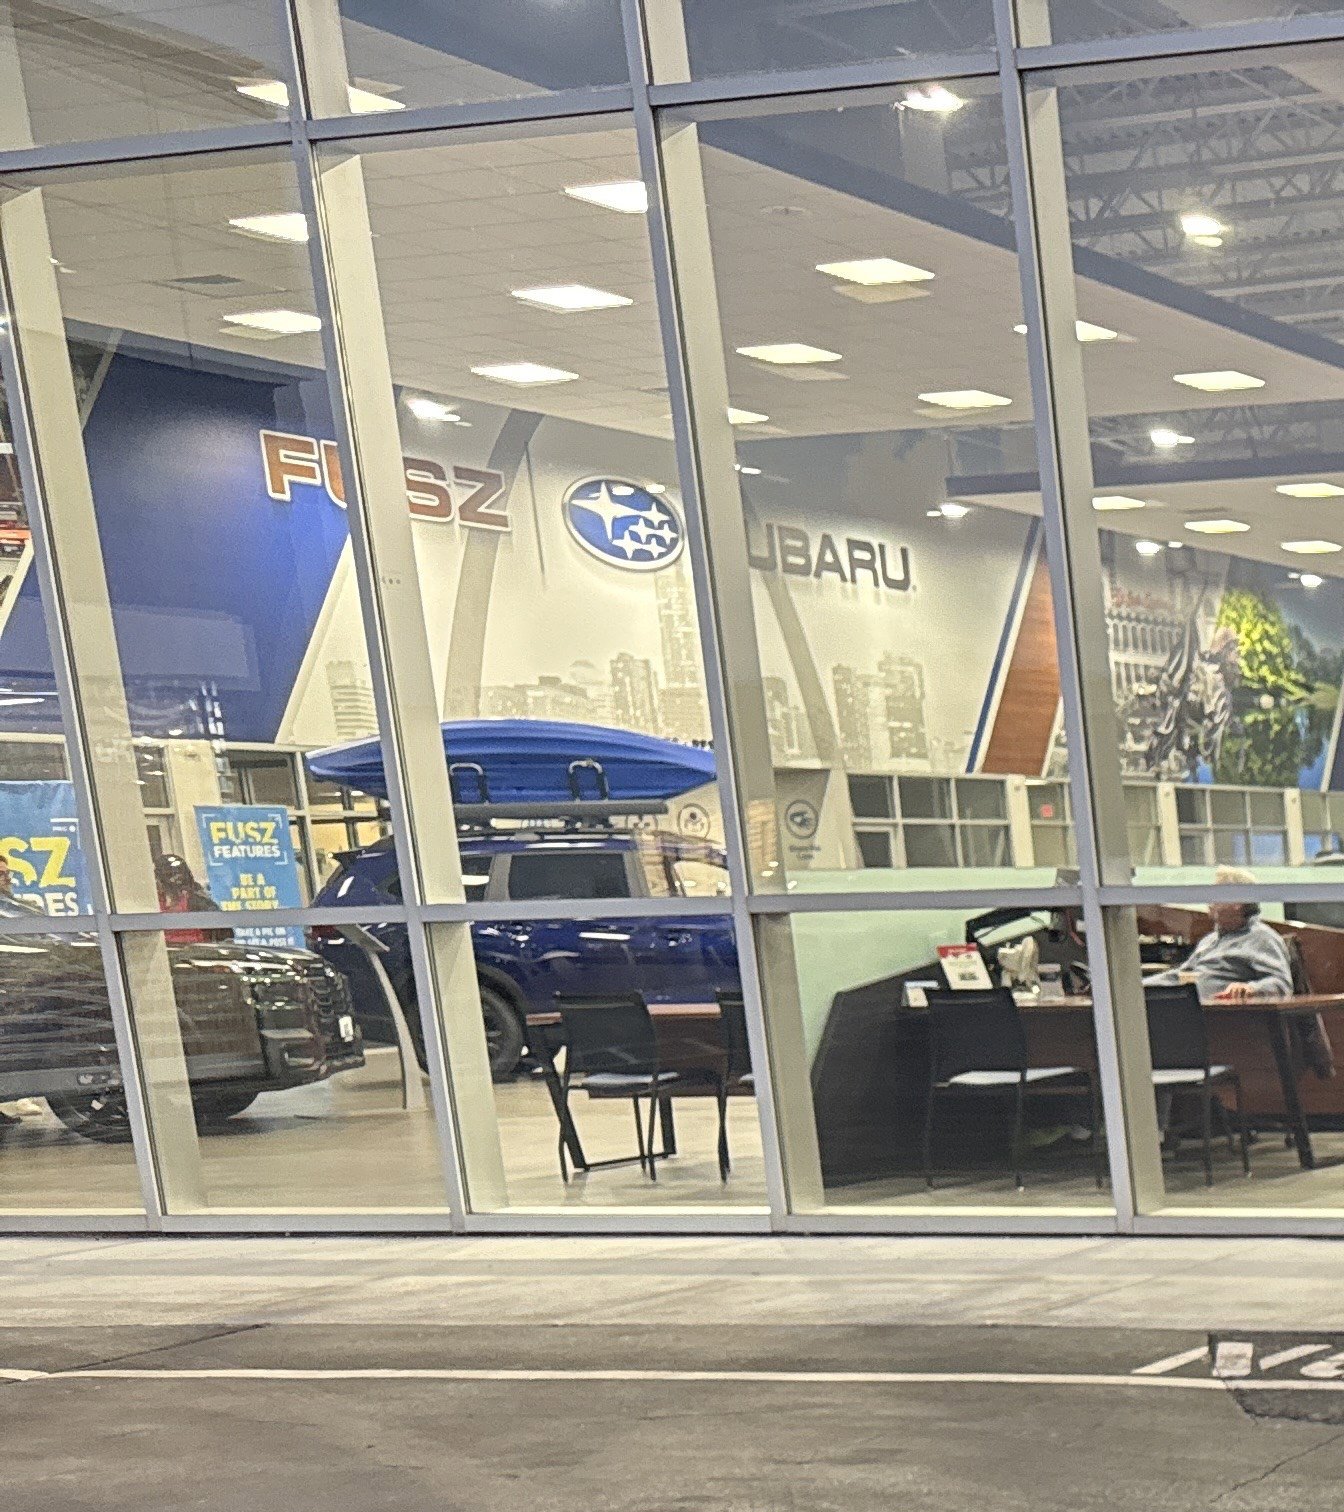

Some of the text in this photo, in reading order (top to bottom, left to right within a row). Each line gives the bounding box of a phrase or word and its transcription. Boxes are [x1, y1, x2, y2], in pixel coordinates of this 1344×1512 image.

[748, 522, 911, 592] UBARU
[210, 821, 279, 845] FUSZ
[213, 845, 281, 859] FEATURES
[0, 836, 76, 888] SZ
